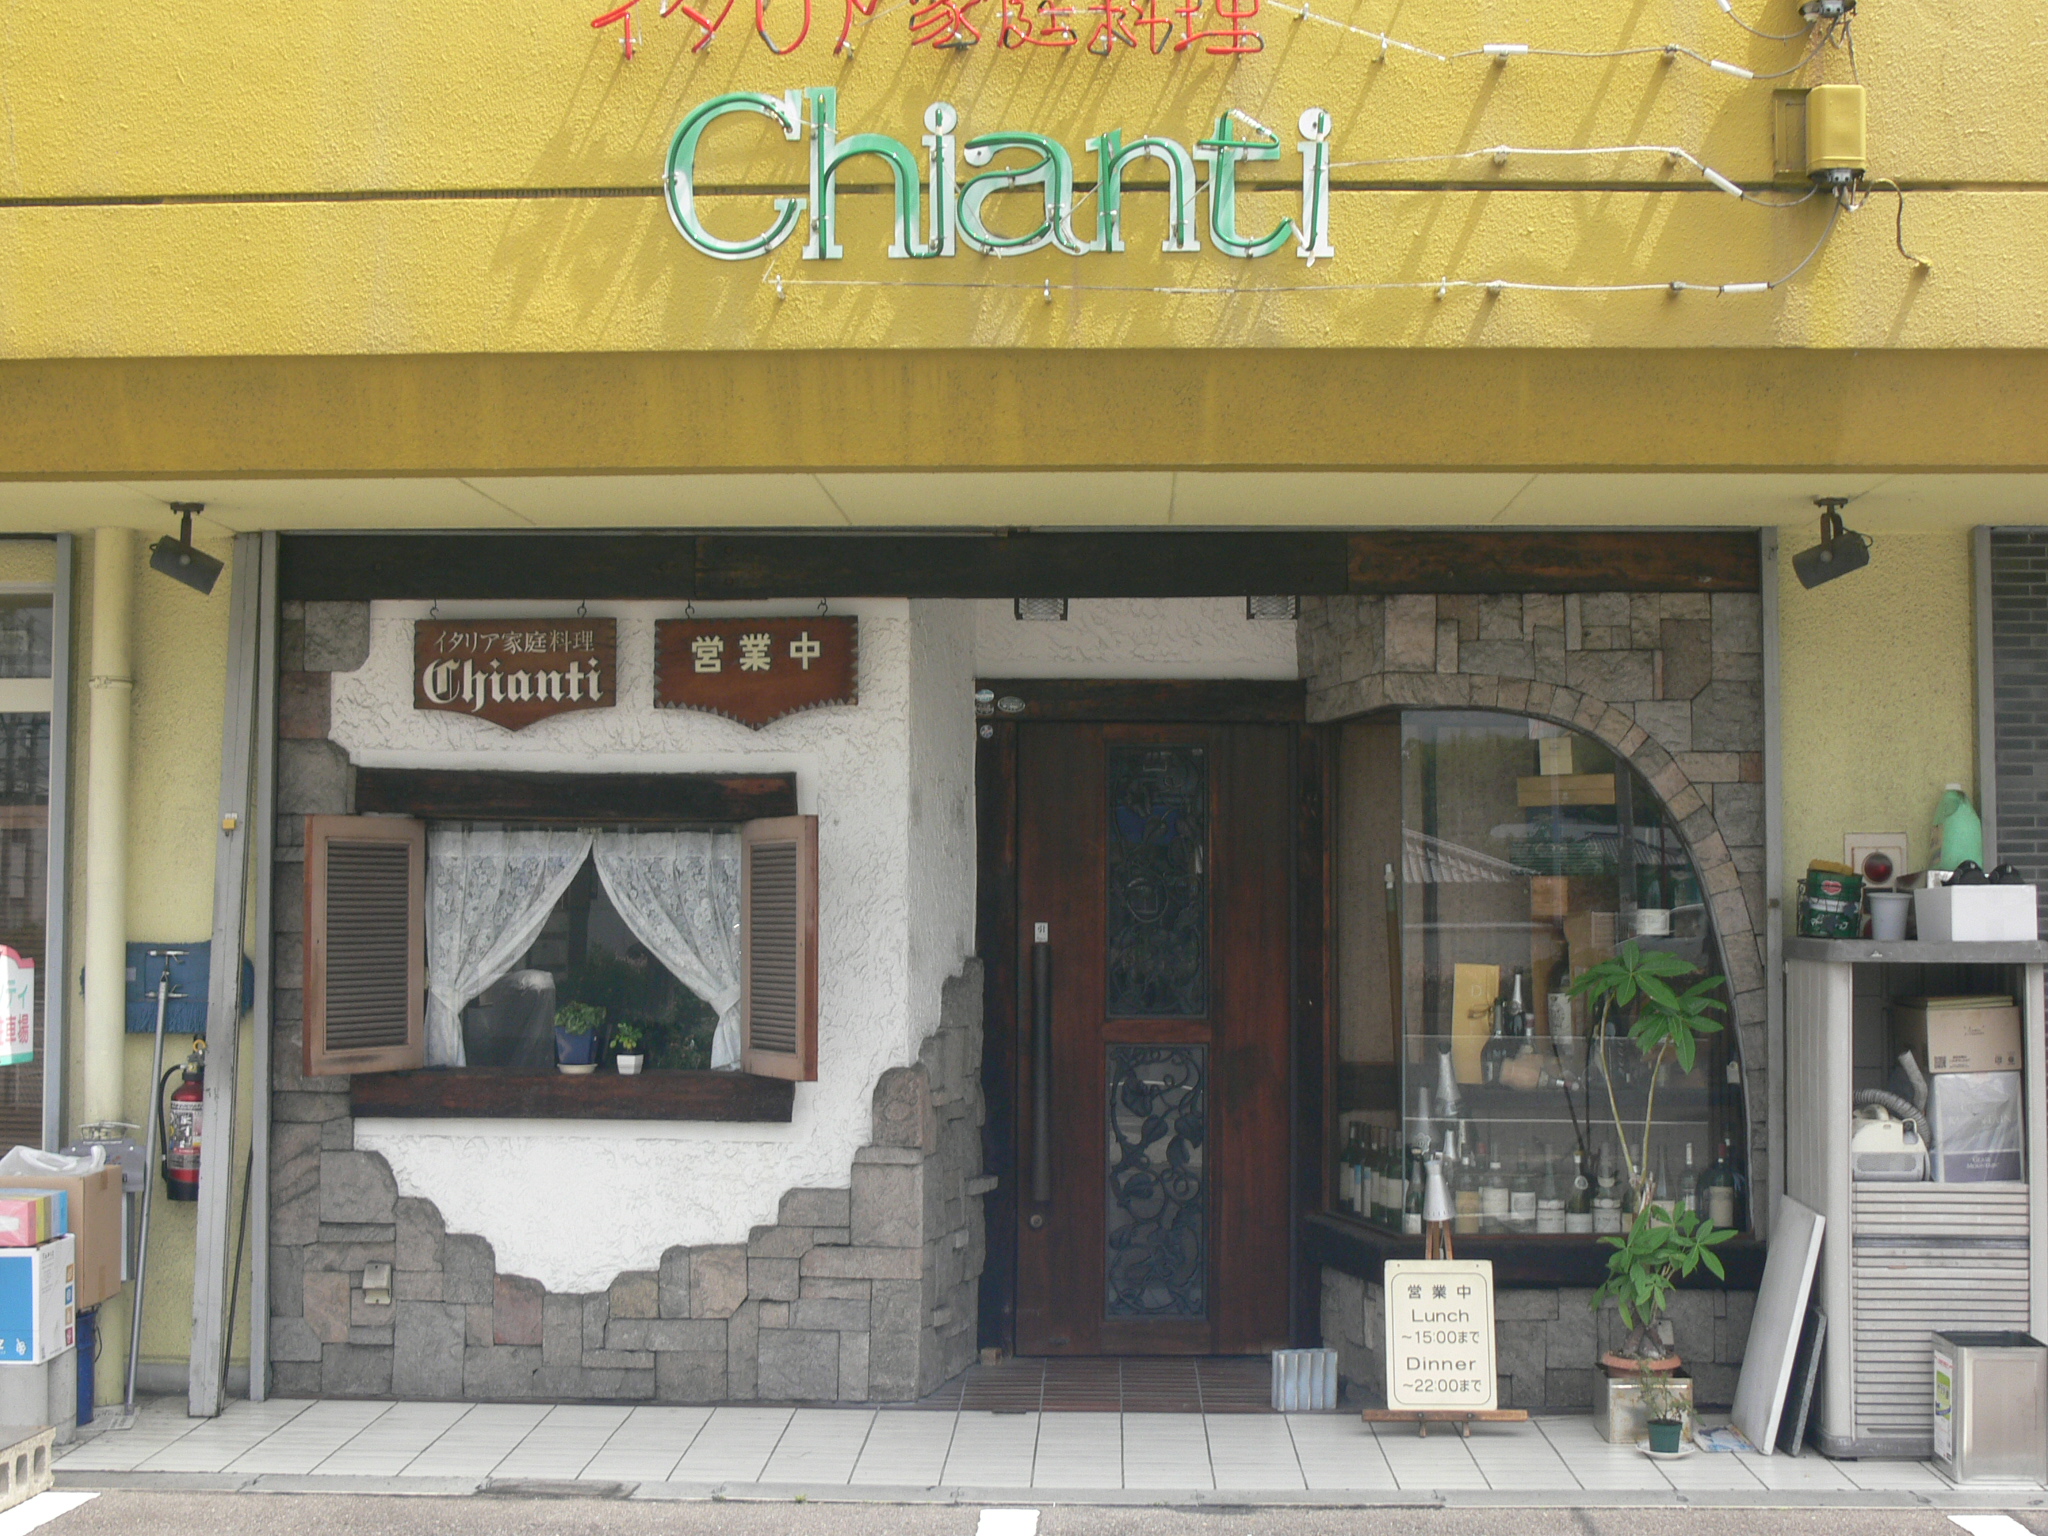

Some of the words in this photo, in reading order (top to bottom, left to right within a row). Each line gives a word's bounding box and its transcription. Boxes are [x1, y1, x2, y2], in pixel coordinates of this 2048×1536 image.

[664, 86, 1336, 263] Chianti
[434, 630, 595, 653] イタリア家庭料理
[691, 632, 820, 673] 営業中
[422, 657, 604, 713] Chianti
[1407, 1284, 1472, 1300] 営業中
[1411, 1309, 1470, 1323] Lunch
[1406, 1356, 1477, 1371] Dinner
